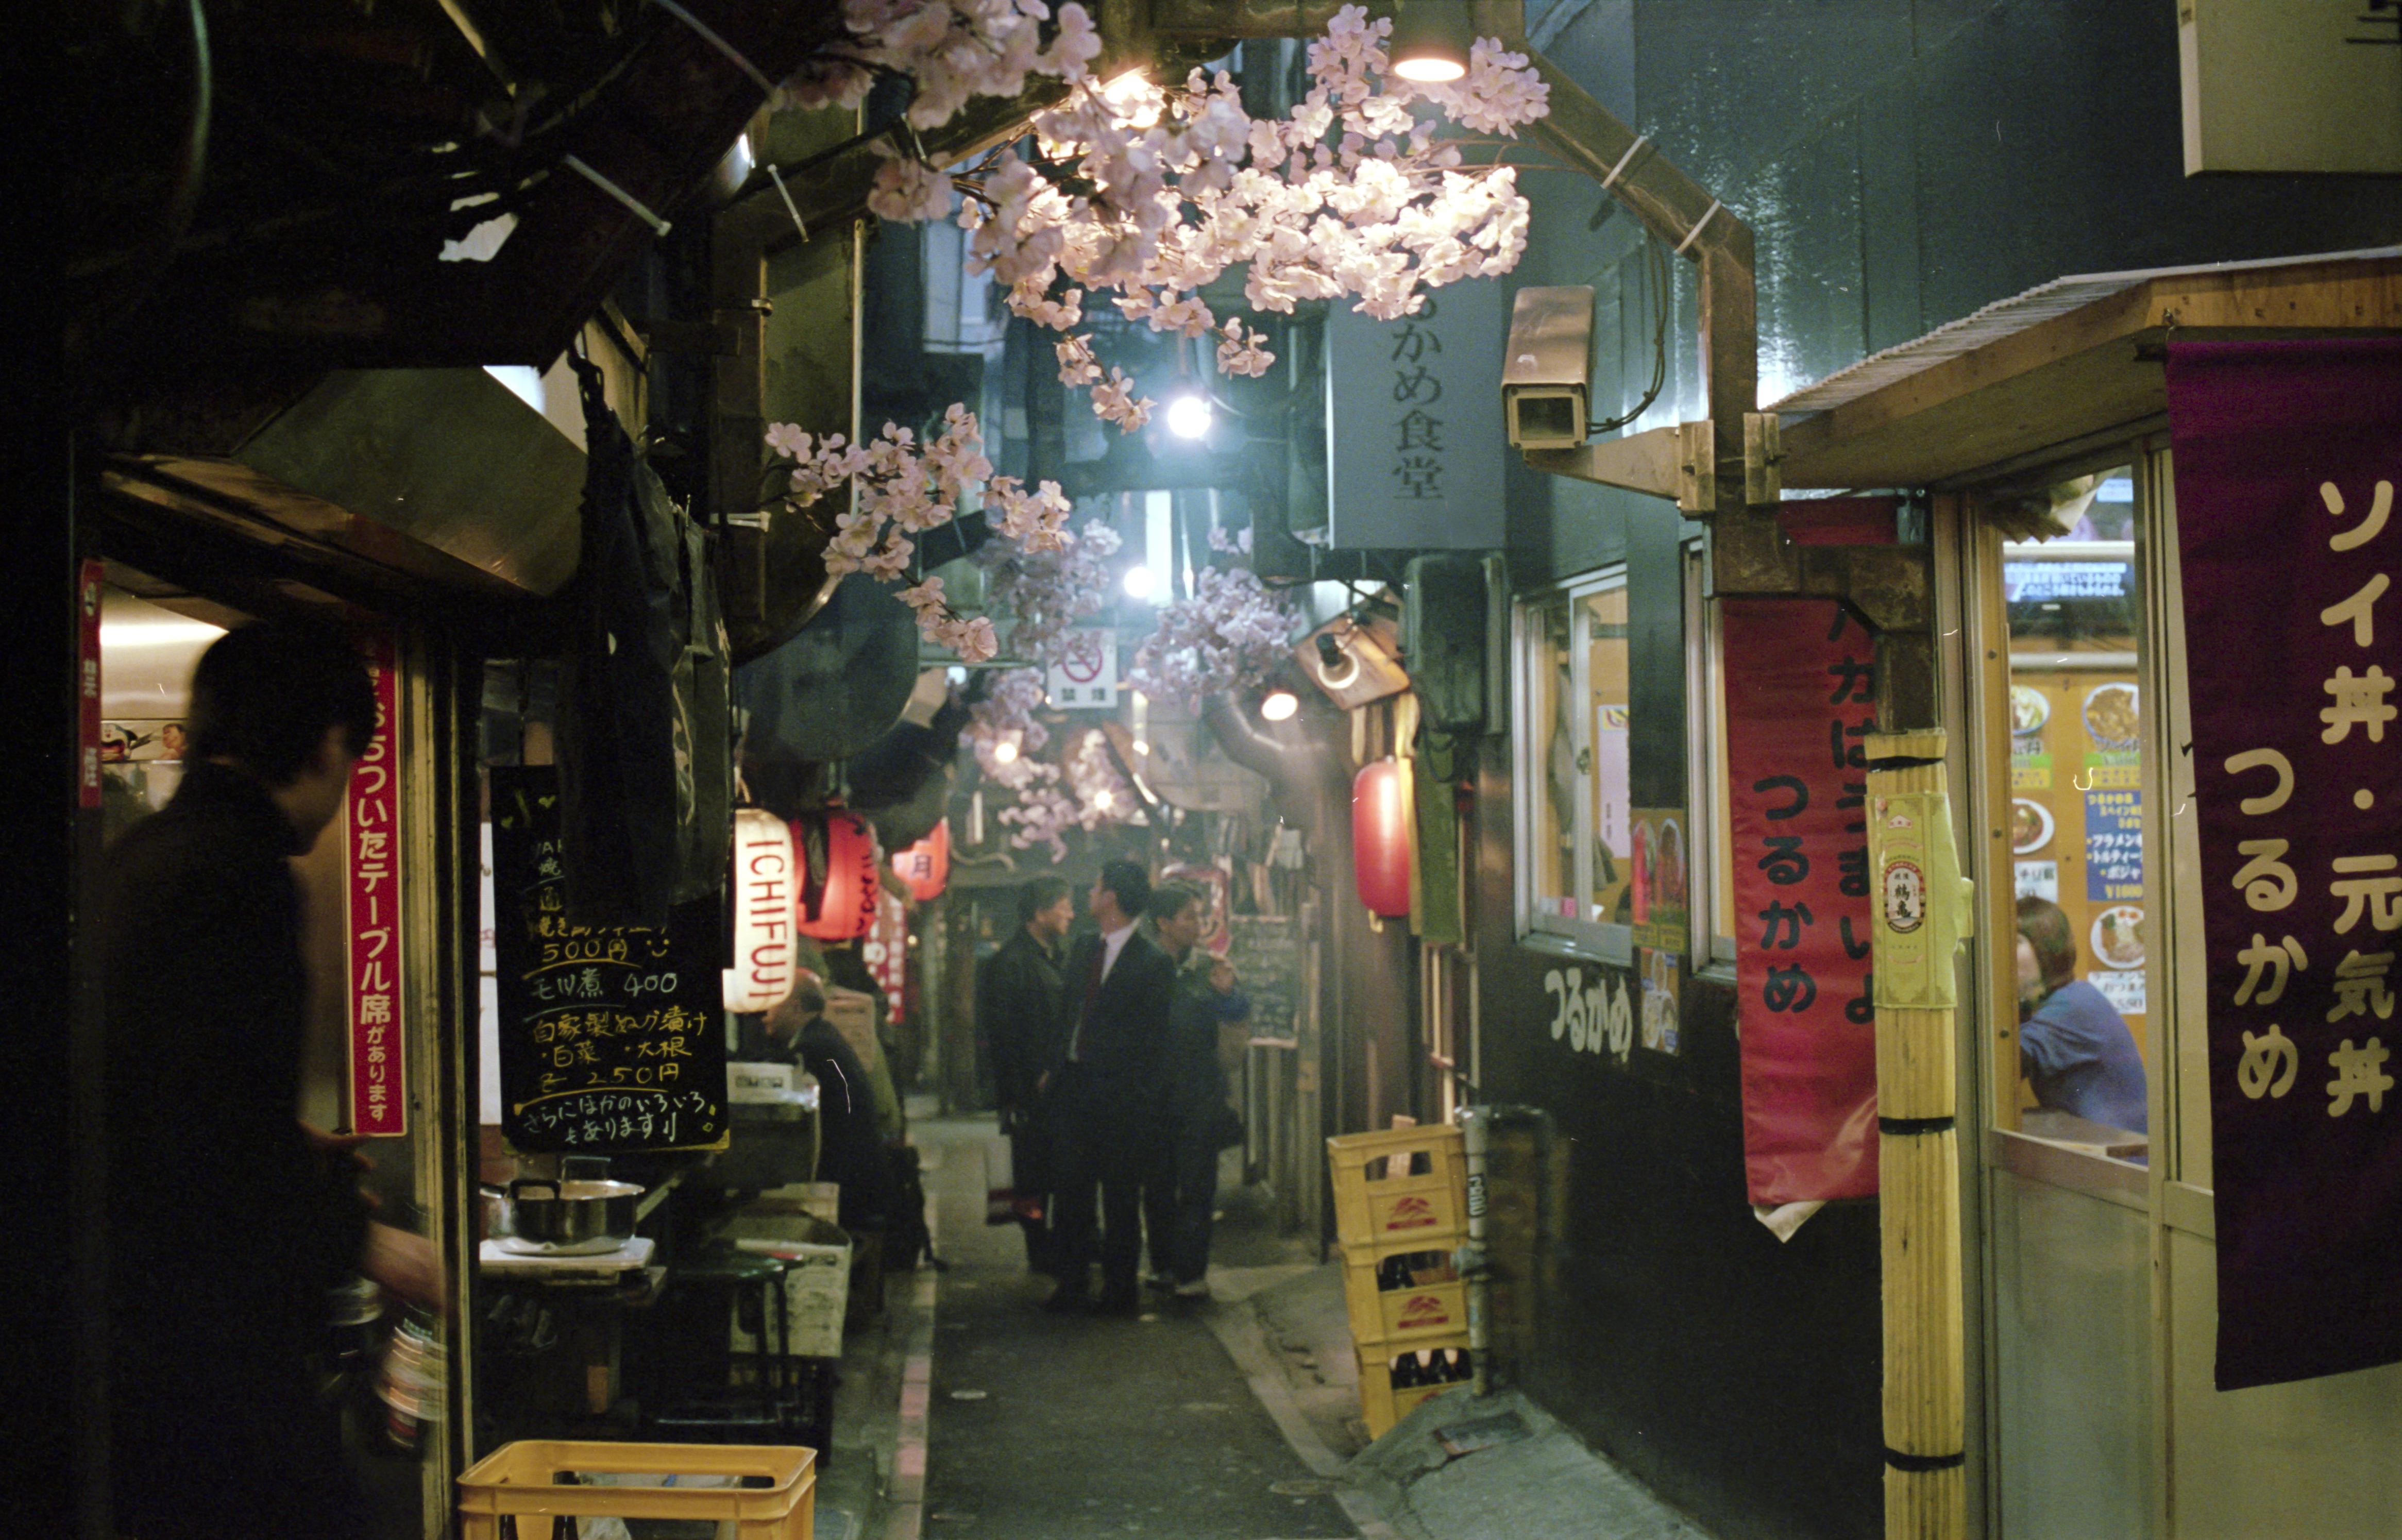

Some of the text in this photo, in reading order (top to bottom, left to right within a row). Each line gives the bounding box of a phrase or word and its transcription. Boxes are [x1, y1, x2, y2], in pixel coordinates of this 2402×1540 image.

[746, 840, 788, 998] ICHIFUJI
[1753, 773, 1818, 1014] つるかめ
[2225, 748, 2308, 1099] つるかめ
[624, 973, 678, 997] 400
[1545, 968, 1633, 1064] つるかめ
